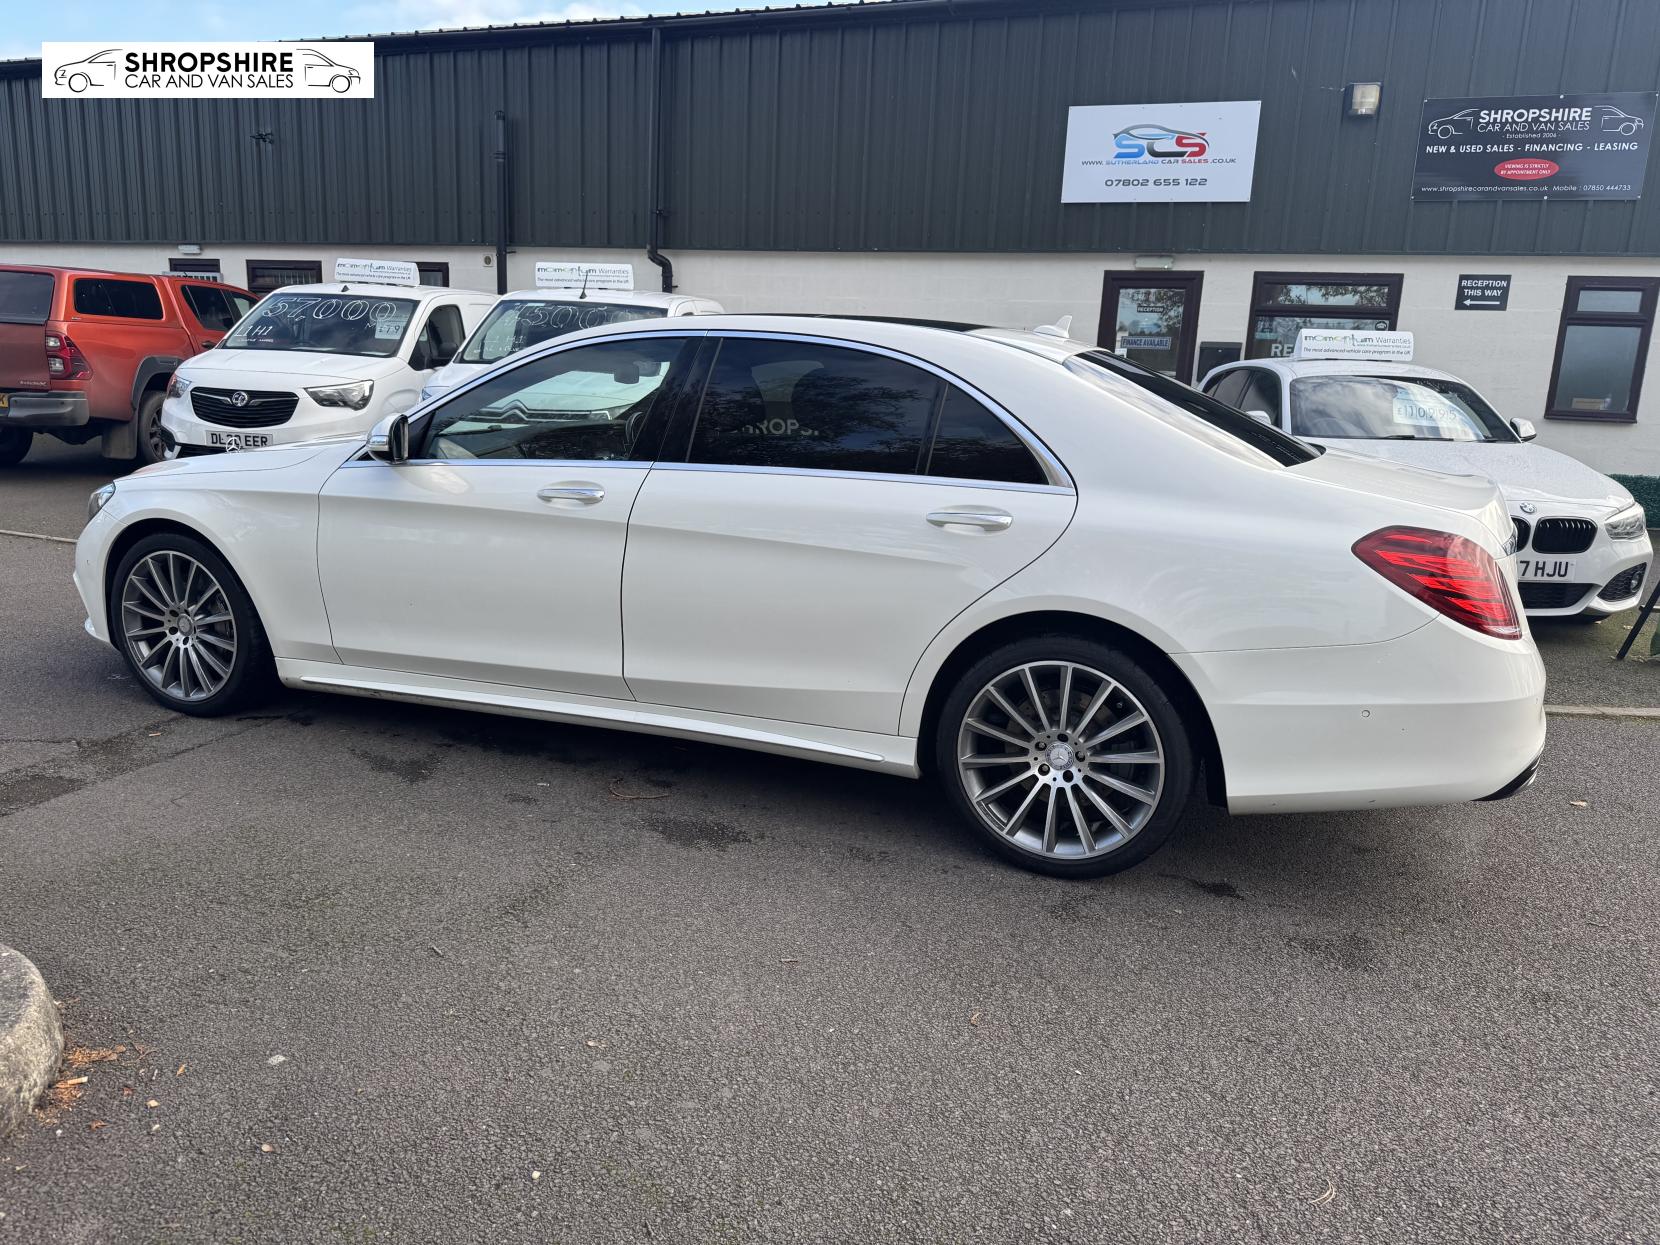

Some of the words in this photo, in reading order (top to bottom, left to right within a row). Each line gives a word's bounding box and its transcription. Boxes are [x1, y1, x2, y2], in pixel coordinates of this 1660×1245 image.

[1478, 107, 1593, 124] SHROPSHIRE
[1477, 123, 1501, 133] CAR
[1504, 122, 1529, 132] AND
[1532, 122, 1556, 132] VAN
[1558, 121, 1590, 131] SALES
[1426, 145, 1447, 154] NEW
[1450, 145, 1456, 153] &
[1460, 144, 1483, 153] USED
[1486, 144, 1514, 153] SALES
[1525, 142, 1583, 153] FINANCING
[1594, 142, 1639, 151] LEASING
[1104, 179, 1149, 188] 07802
[1153, 179, 1180, 187] 655
[1185, 178, 1208, 186] 122
[1421, 184, 1548, 193] www.shropshirecarandvansales.co.uk
[1461, 279, 1507, 287] RECEPTION
[1375, 336, 1411, 345] Warranties
[244, 435, 268, 447] EER
[1534, 561, 1569, 578] HJU
